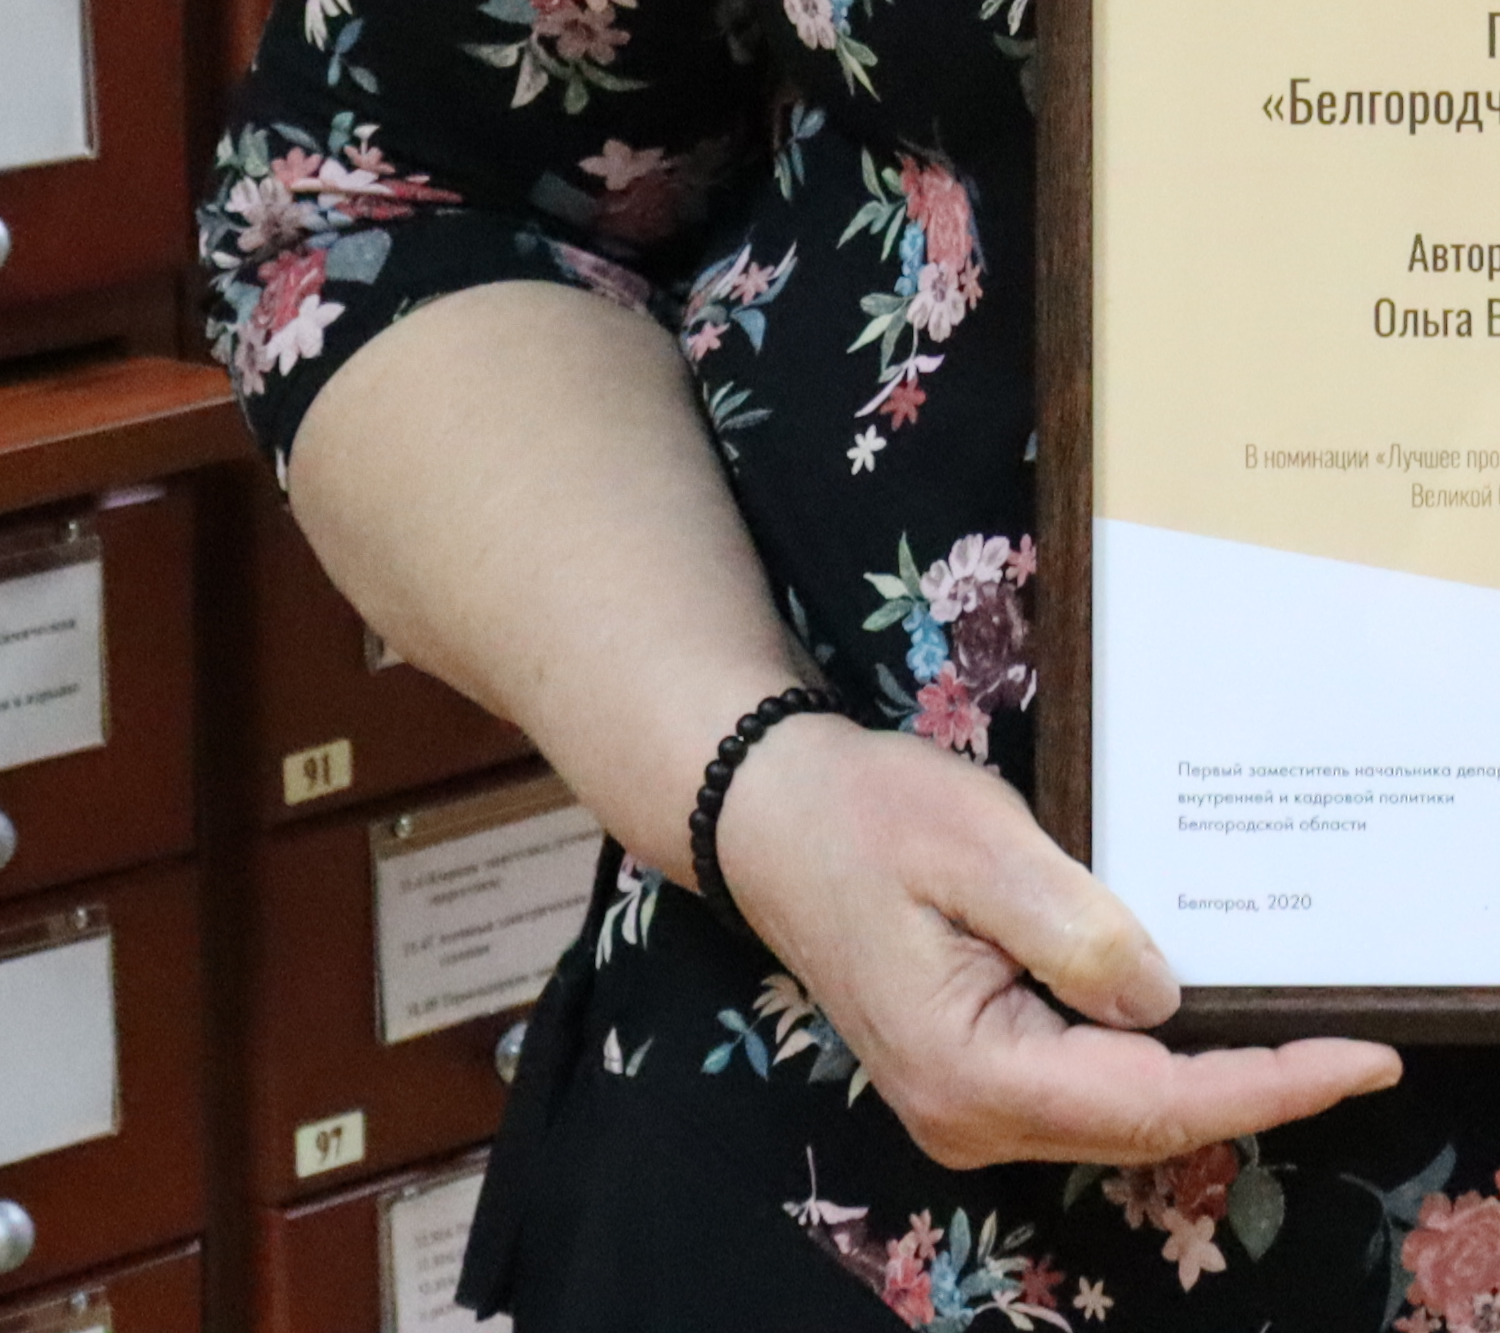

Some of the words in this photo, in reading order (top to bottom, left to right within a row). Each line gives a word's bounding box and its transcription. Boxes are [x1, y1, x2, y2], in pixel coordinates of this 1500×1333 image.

[1373, 297, 1473, 339] Ольга
[1244, 443, 1259, 470] В
[1263, 449, 1370, 472] номинации
[1375, 442, 1461, 474] «Лучшее
[1410, 481, 1493, 509] Великой
[303, 751, 331, 788] 91
[1177, 760, 1243, 782] Первый
[1249, 765, 1351, 778] заместитель
[1354, 765, 1452, 778] начальника
[1177, 789, 1275, 809] внутренней
[1278, 794, 1289, 804] и
[1293, 789, 1375, 809] кадровой
[1378, 793, 1455, 805] политики
[1177, 814, 1295, 836] Белгородской
[1298, 815, 1368, 832] области
[1177, 893, 1260, 914] Белгород,
[1267, 893, 1313, 911] 2020
[316, 1126, 343, 1161] 97
